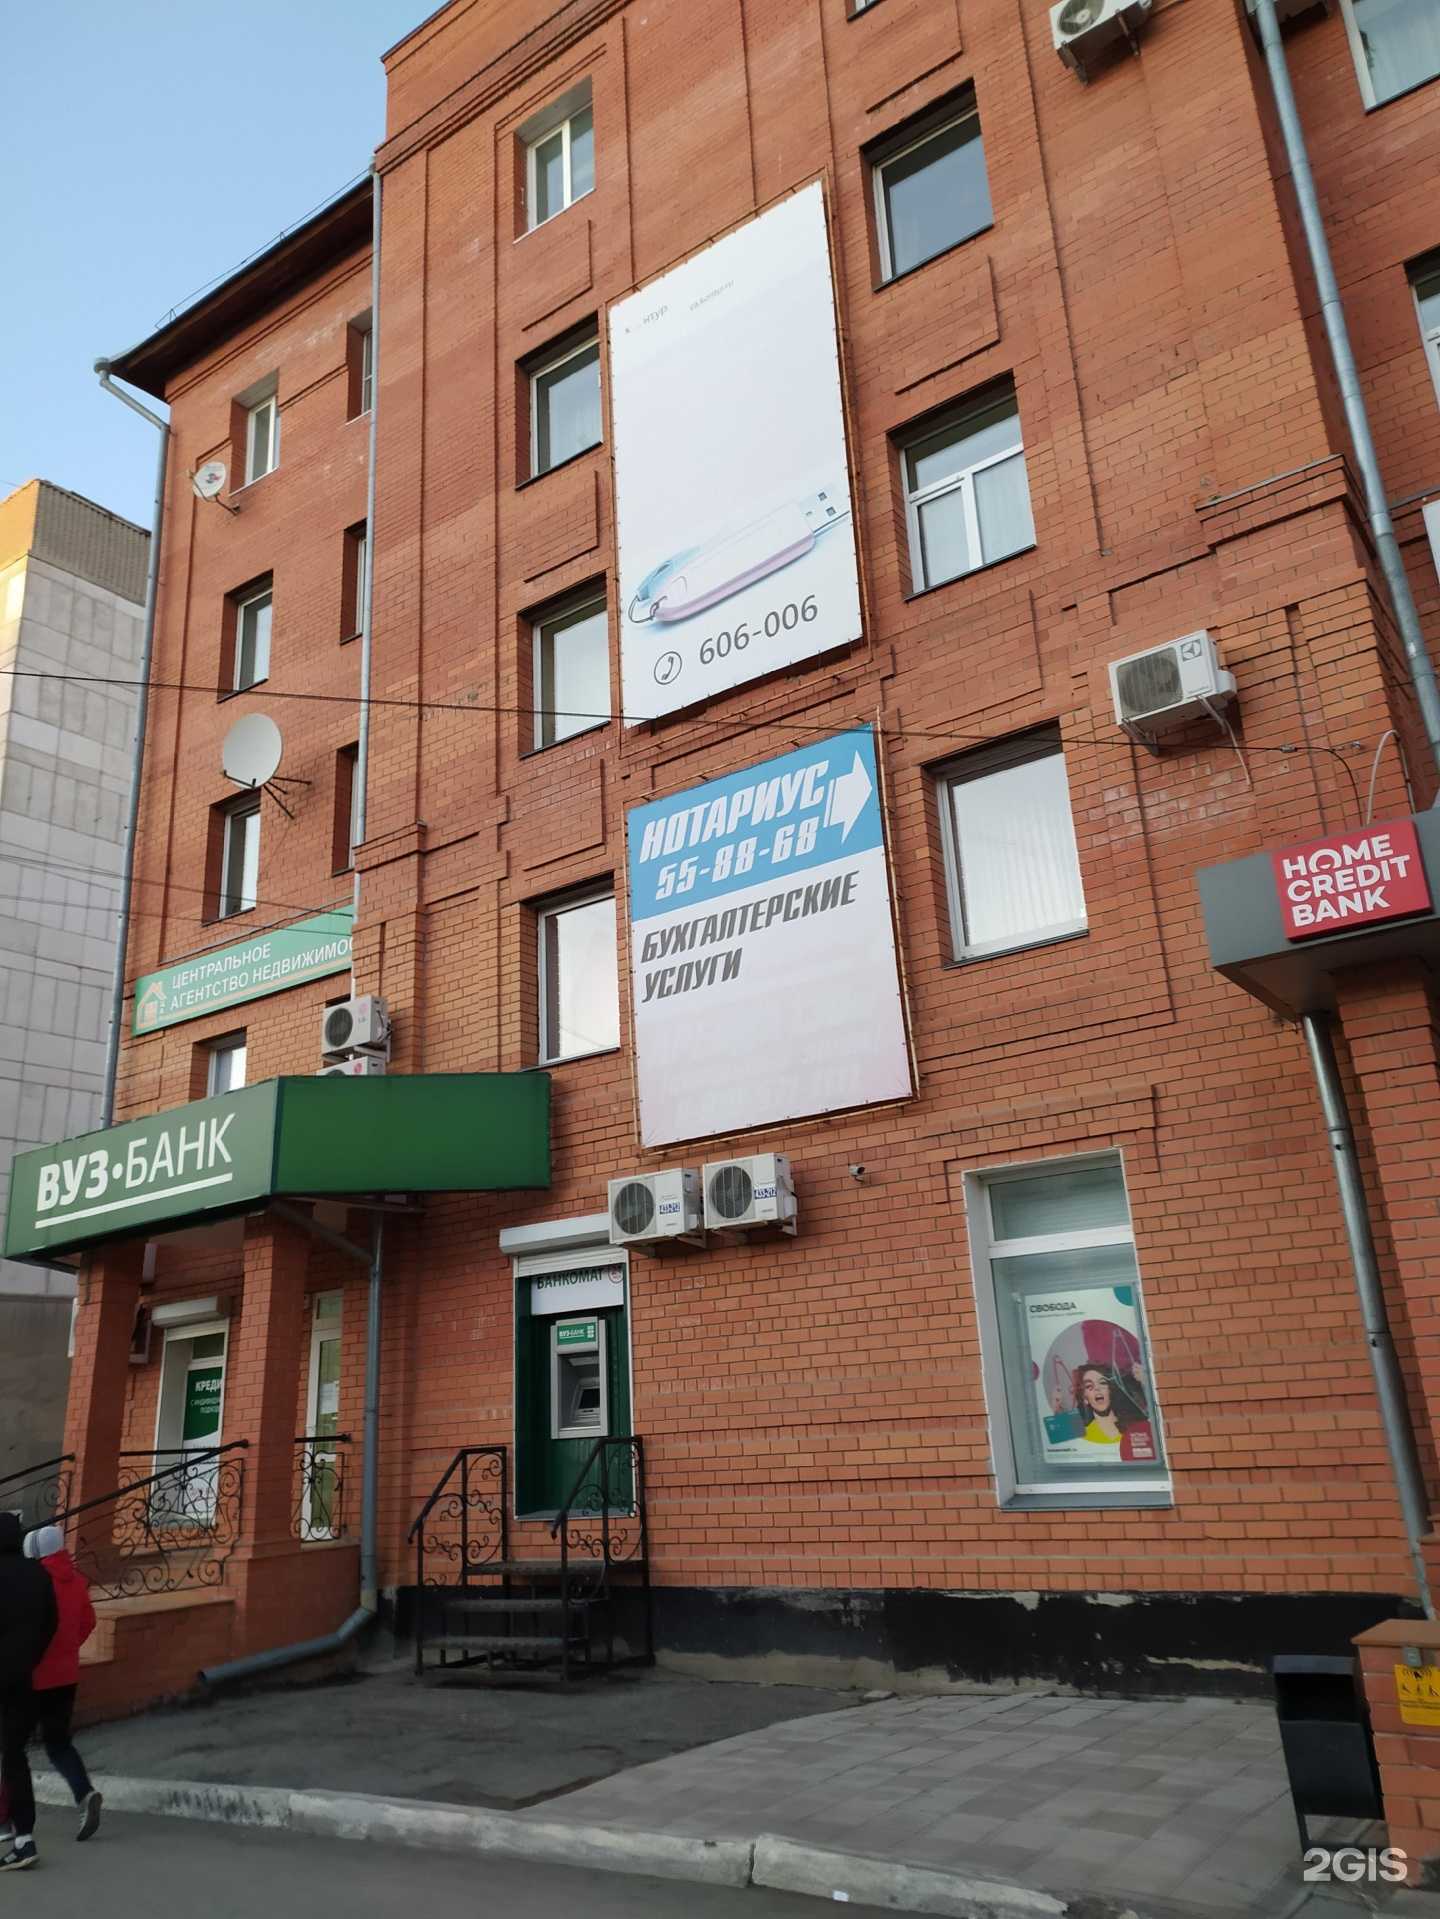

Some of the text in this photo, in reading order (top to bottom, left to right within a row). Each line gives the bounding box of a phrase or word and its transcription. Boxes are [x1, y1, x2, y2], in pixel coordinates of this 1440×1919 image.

[700, 594, 818, 665] 606-006
[639, 760, 829, 864] НОТАРИУС
[655, 816, 820, 901] 55-88-68
[1282, 833, 1394, 879] HOME
[1287, 854, 1411, 902] CREDIT
[641, 870, 860, 963] БУХГАЛТЕРСКИЕ
[1291, 886, 1391, 927] BANK
[172, 942, 272, 989] ЦЕНТРАЛЬНОЕ
[641, 947, 743, 1003] УСЛУГИ
[170, 972, 249, 1011] АГЕНТСТВО
[537, 1268, 604, 1290] БАНКОМАТ
[1029, 1302, 1077, 1313] СВОБОДА
